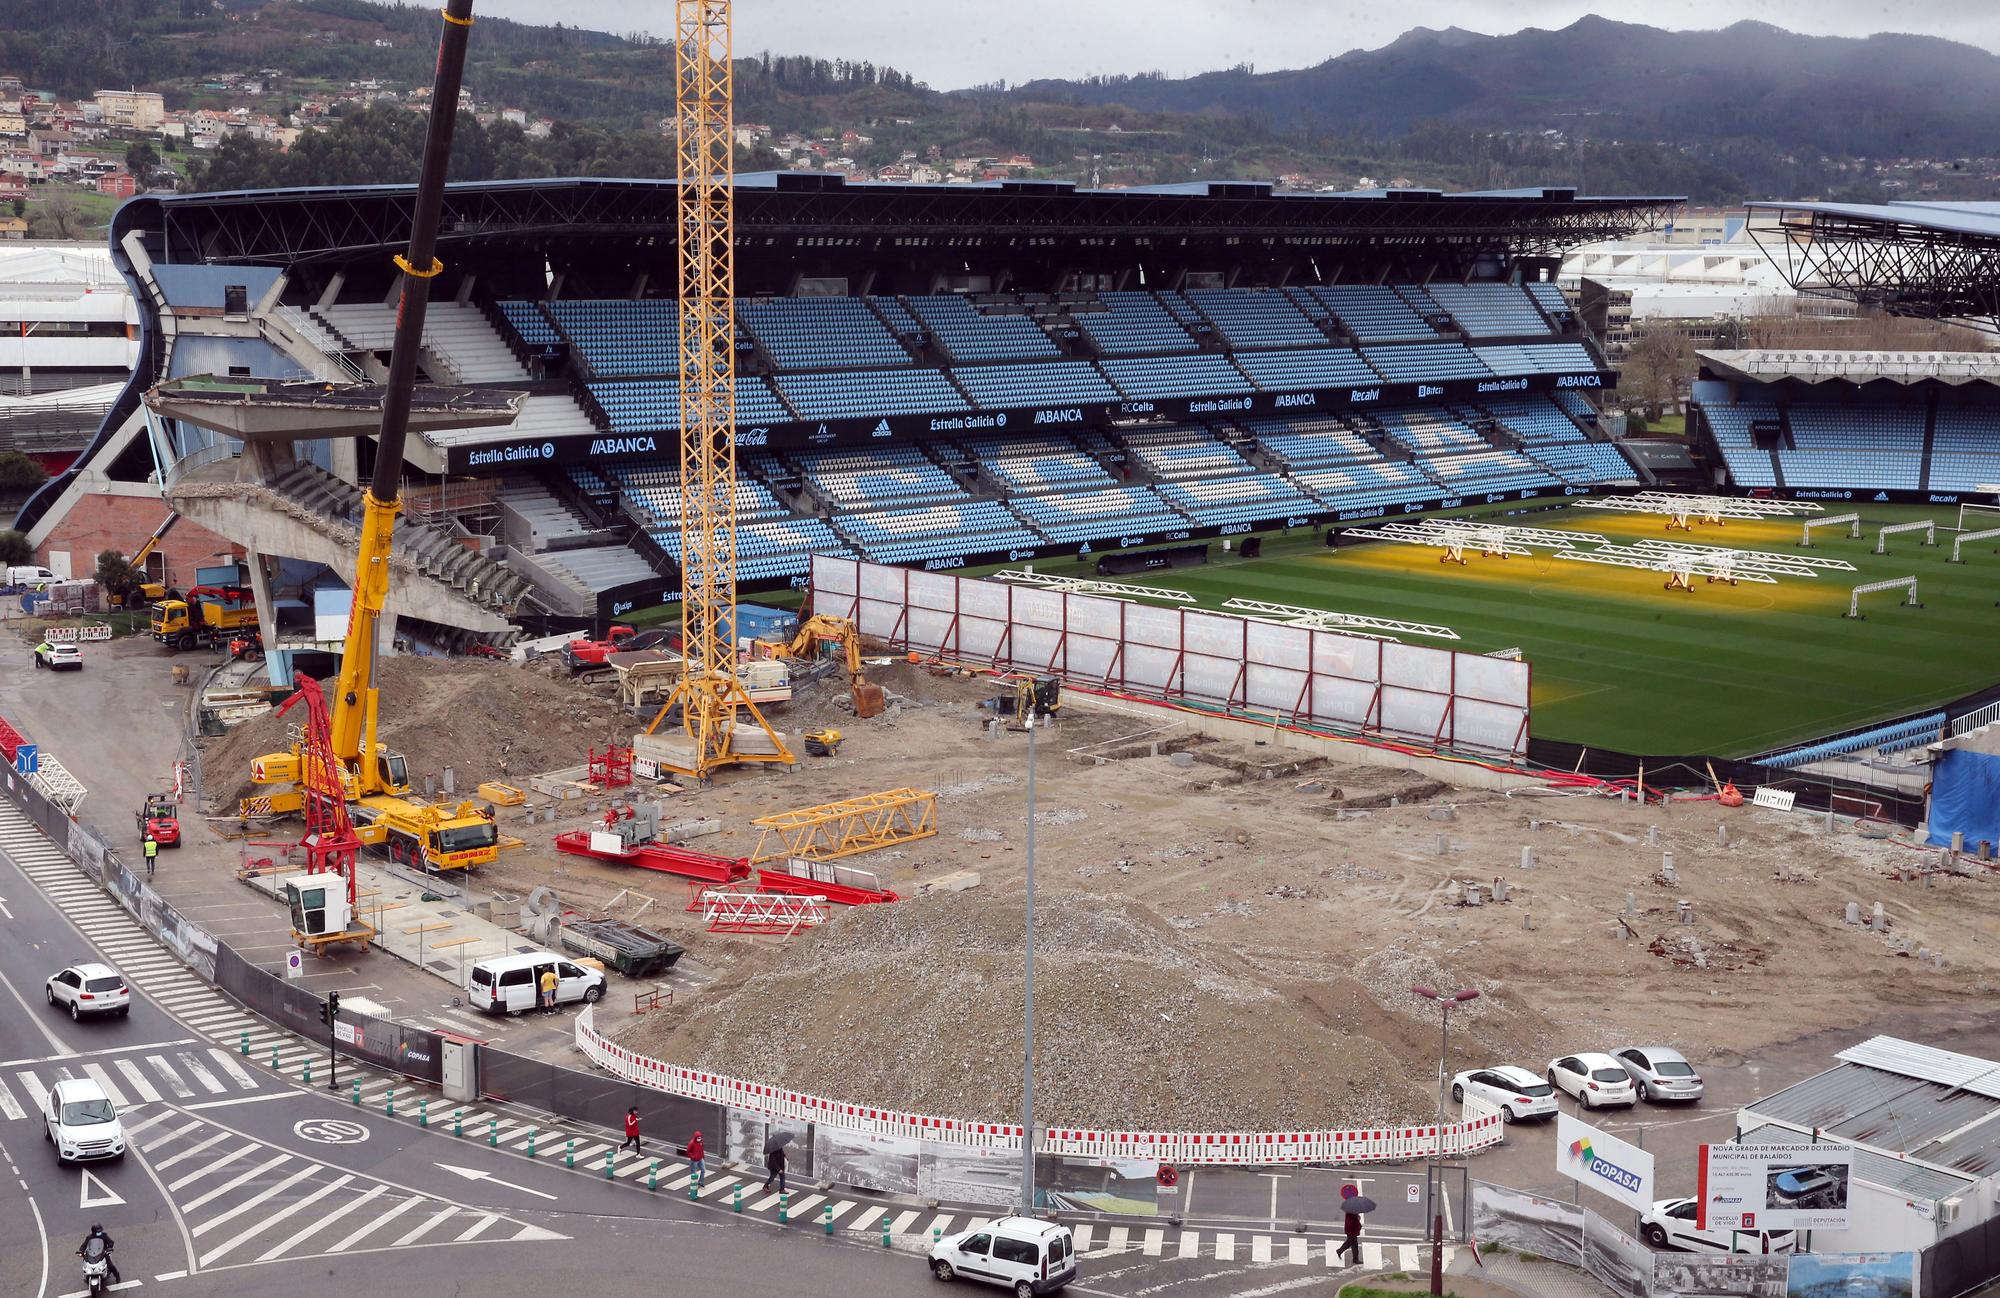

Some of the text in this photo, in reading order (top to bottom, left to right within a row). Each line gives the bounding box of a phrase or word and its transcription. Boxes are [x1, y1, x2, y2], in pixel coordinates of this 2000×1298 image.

[1478, 380, 1520, 393] Estrella Galicia
[1561, 376, 1601, 388] ABANCA
[1279, 393, 1315, 407] ABANCA
[1351, 388, 1380, 402] Recalvi
[1190, 399, 1243, 413] Estrella Galicia
[930, 415, 995, 431] Estrella Galicia
[1038, 409, 1083, 424] ABANCA
[599, 437, 657, 455] ABANCA
[469, 444, 540, 466] Estrella Galicia
[1796, 490, 1843, 498] Estrella Galicia
[1929, 494, 1958, 503] Recalvi
[1223, 523, 1252, 535] ABANCA
[929, 557, 964, 570] ABANCA
[407, 1051, 430, 1062] COPASA
[303, 1122, 360, 1140] 30
[1760, 1152, 1792, 1160] BALAÍDOS
[1593, 1159, 1638, 1191] COPASA
